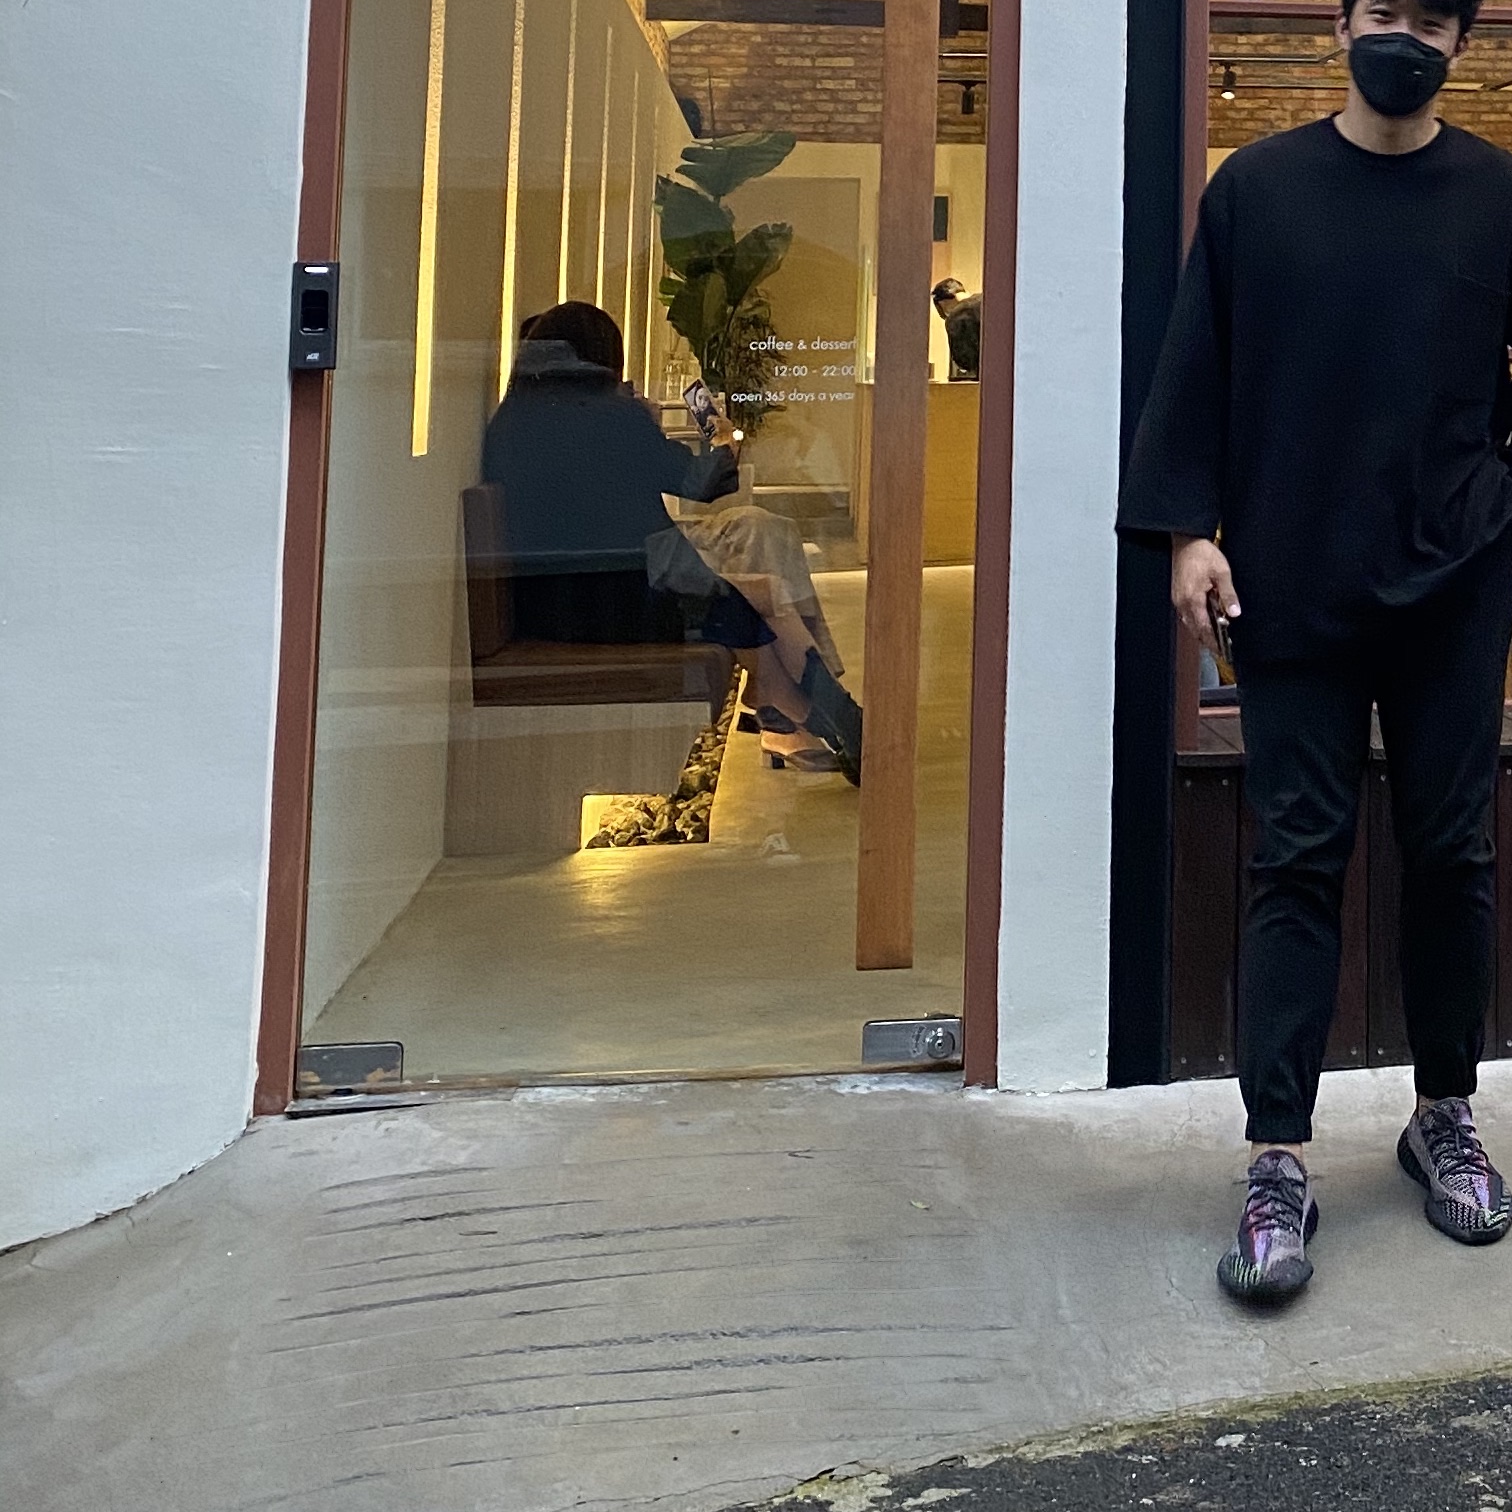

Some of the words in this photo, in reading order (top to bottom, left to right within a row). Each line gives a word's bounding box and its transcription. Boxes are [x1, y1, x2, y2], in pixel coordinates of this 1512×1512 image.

[749, 335, 794, 351] coffee
[797, 339, 808, 350] &
[811, 335, 857, 350] dessert
[774, 365, 809, 377] 12:00
[821, 365, 856, 377] 22:00
[731, 392, 762, 403] open
[765, 390, 785, 401] 365
[788, 388, 816, 402] days
[818, 393, 827, 401] a
